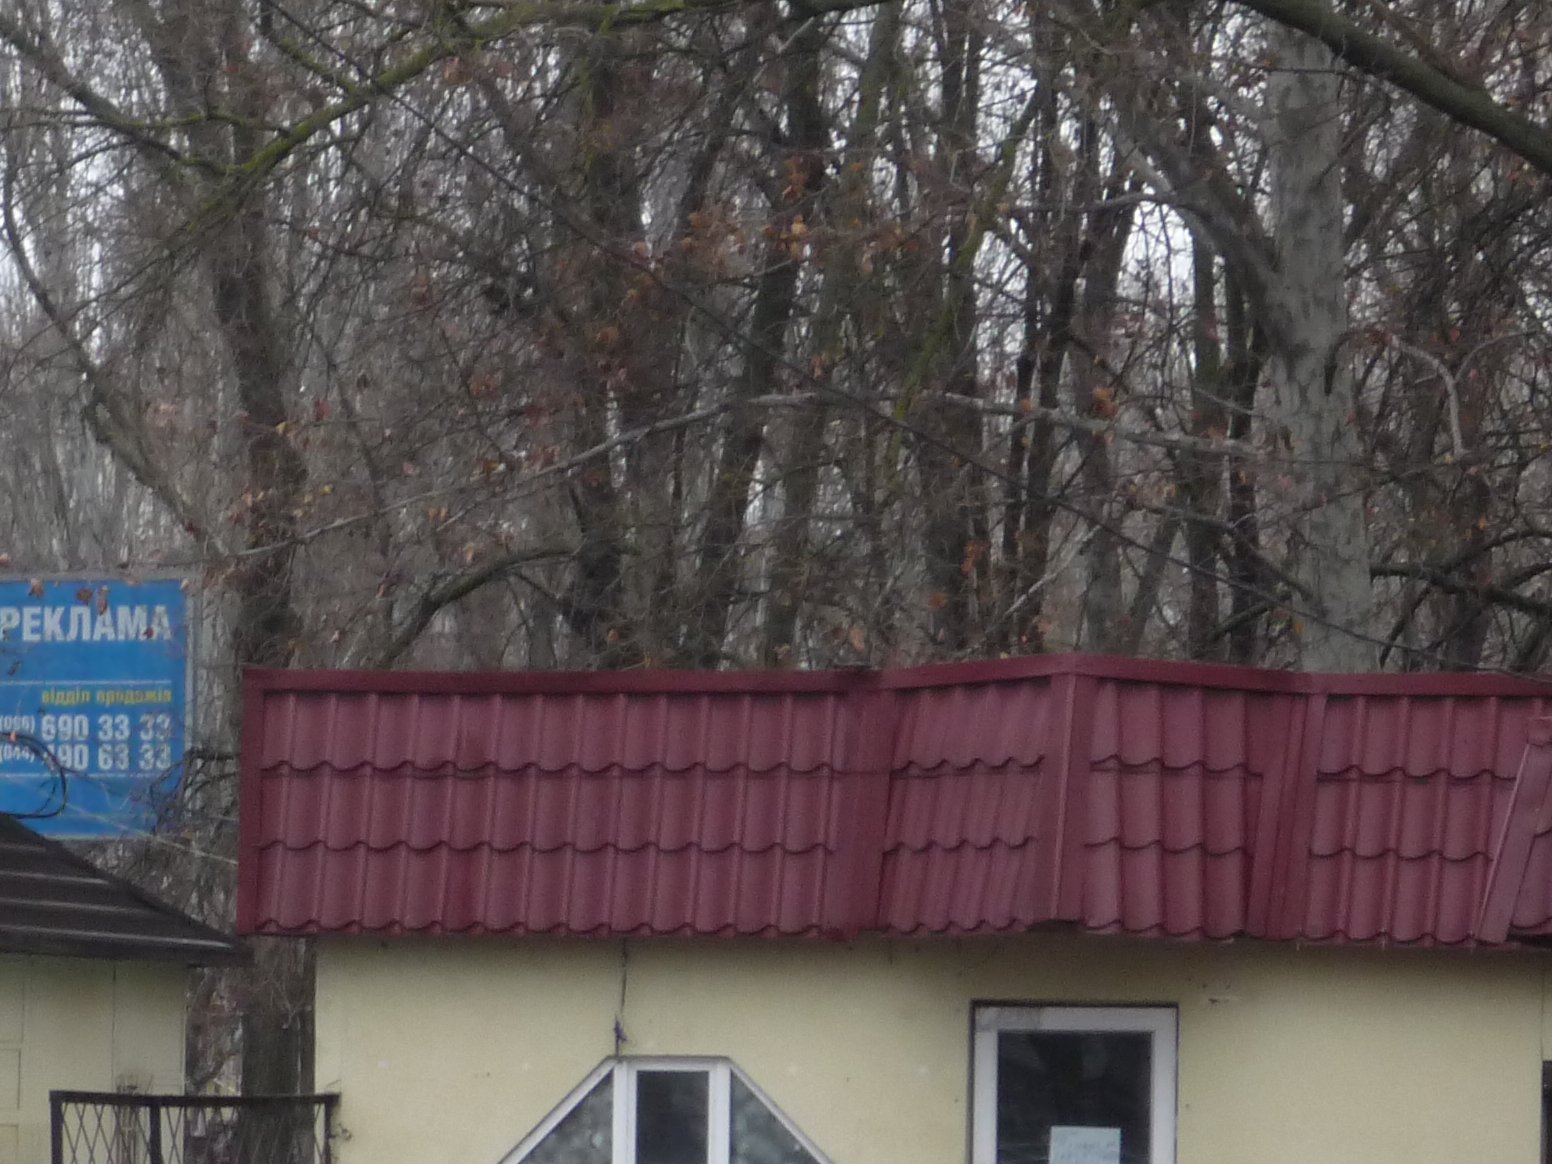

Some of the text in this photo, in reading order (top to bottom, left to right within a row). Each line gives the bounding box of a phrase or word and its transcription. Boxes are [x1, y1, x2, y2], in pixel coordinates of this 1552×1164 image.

[0, 605, 172, 642] РЕКЛАМА
[42, 714, 89, 741] 690
[98, 714, 130, 741] 33
[98, 743, 130, 770] 63
